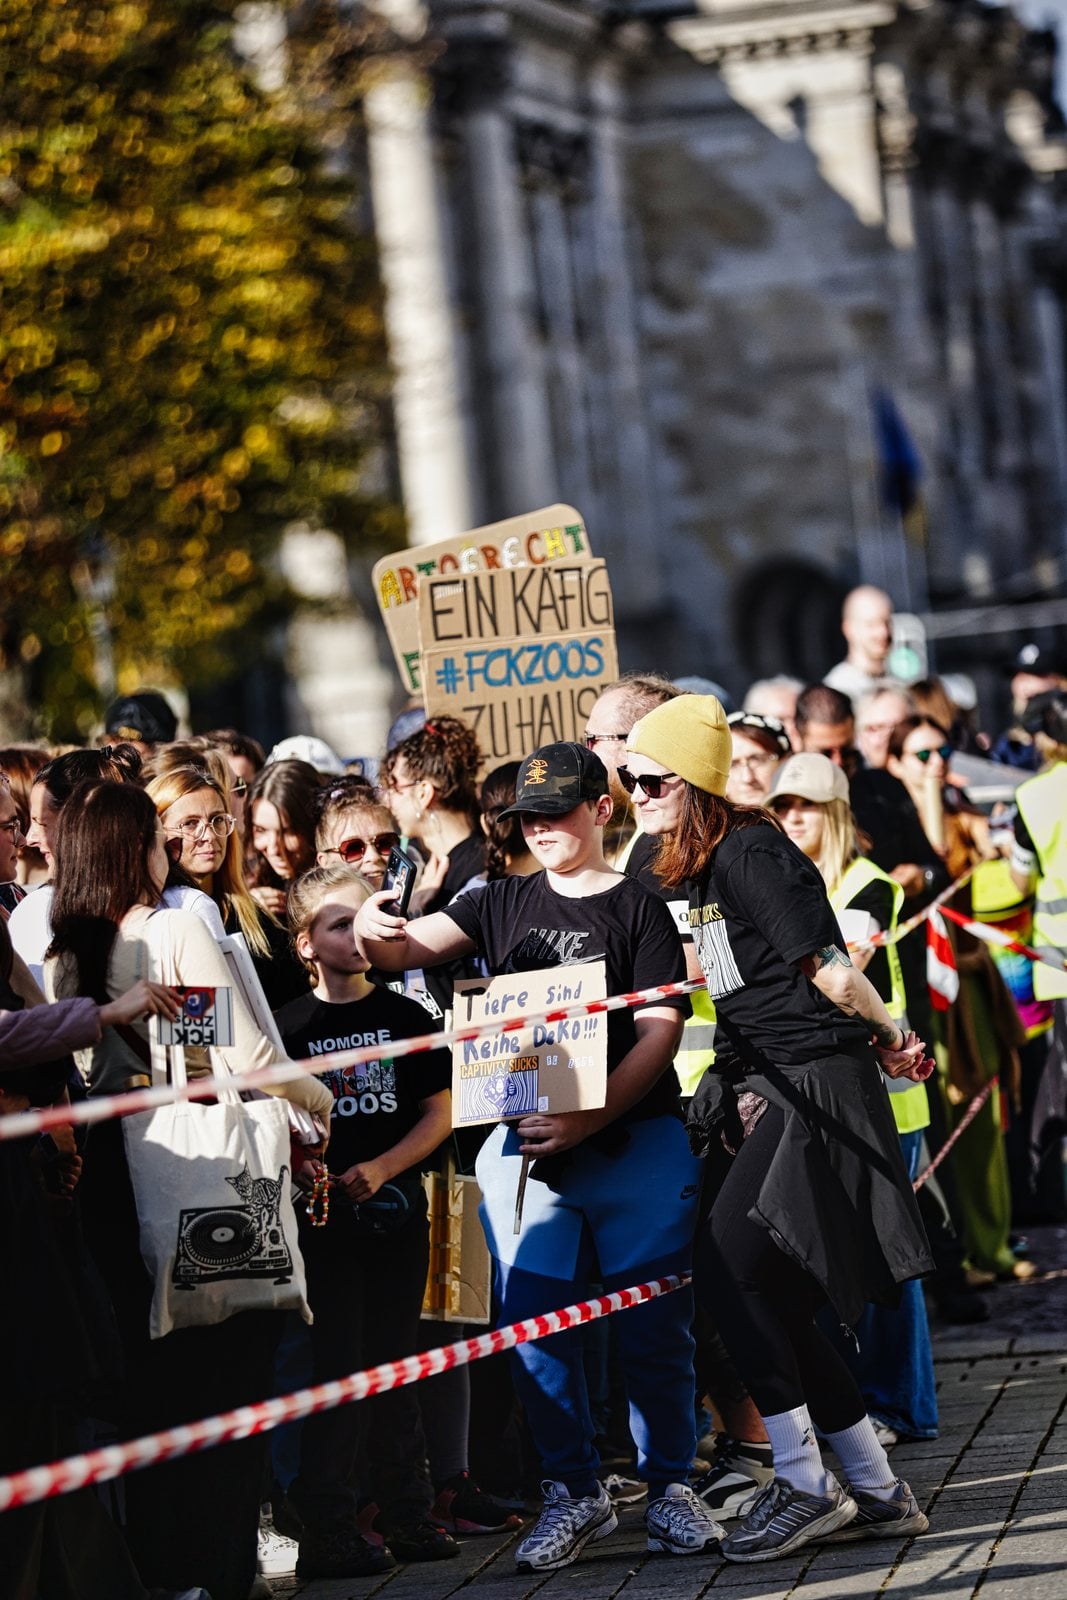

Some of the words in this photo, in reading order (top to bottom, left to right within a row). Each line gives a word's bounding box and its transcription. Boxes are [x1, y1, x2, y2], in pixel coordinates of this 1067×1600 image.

[429, 574, 500, 642] EIN
[511, 566, 611, 636] KÄFIG
[436, 637, 605, 695] #FCKZOOS
[518, 928, 590, 961] NIKE
[460, 986, 529, 1022] Tiere
[174, 1028, 215, 1046] FCK
[308, 1028, 393, 1056] NOMORE
[461, 1060, 507, 1079] CAPTIVITY
[508, 1056, 538, 1073] SUCKS
